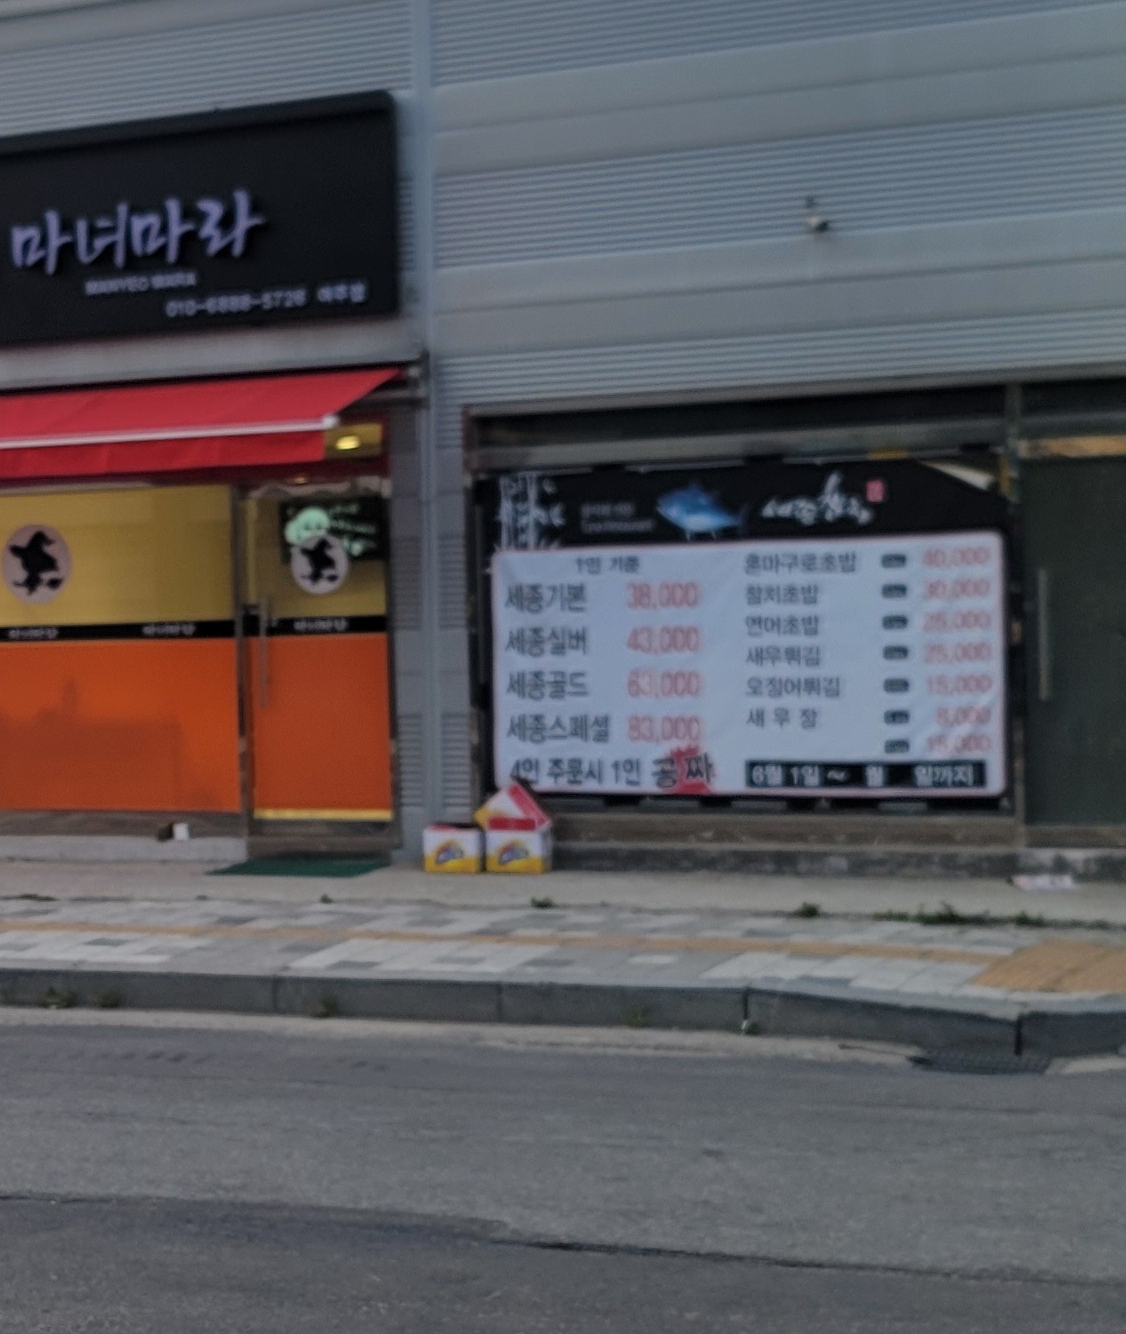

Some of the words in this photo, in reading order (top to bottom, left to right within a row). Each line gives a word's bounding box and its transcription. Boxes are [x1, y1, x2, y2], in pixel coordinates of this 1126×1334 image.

[10, 188, 266, 276] 마녀마라
[577, 557, 603, 574] 1인
[609, 556, 641, 573] 기준
[745, 552, 856, 575] 혼마구로초밥
[505, 583, 586, 613] 세종기본
[628, 581, 700, 610] 38,000
[745, 583, 818, 605] 참치초밥
[745, 614, 819, 636] 연어초밥
[505, 626, 587, 658] 세종실버
[627, 624, 700, 654] 43,000
[746, 644, 820, 667] 새우튀김
[506, 669, 589, 701] 세종골드
[627, 669, 701, 699] 63,000
[746, 676, 840, 698] 오징어튀김
[506, 712, 610, 744] 세종스페셜
[628, 714, 702, 744] 83,000
[512, 757, 541, 785] 4인
[547, 757, 604, 785] 주문시
[610, 757, 641, 786] 1인
[751, 765, 783, 787] 6월
[791, 765, 820, 787] 1일
[866, 765, 884, 787] 월
[914, 765, 974, 788] 일까지
